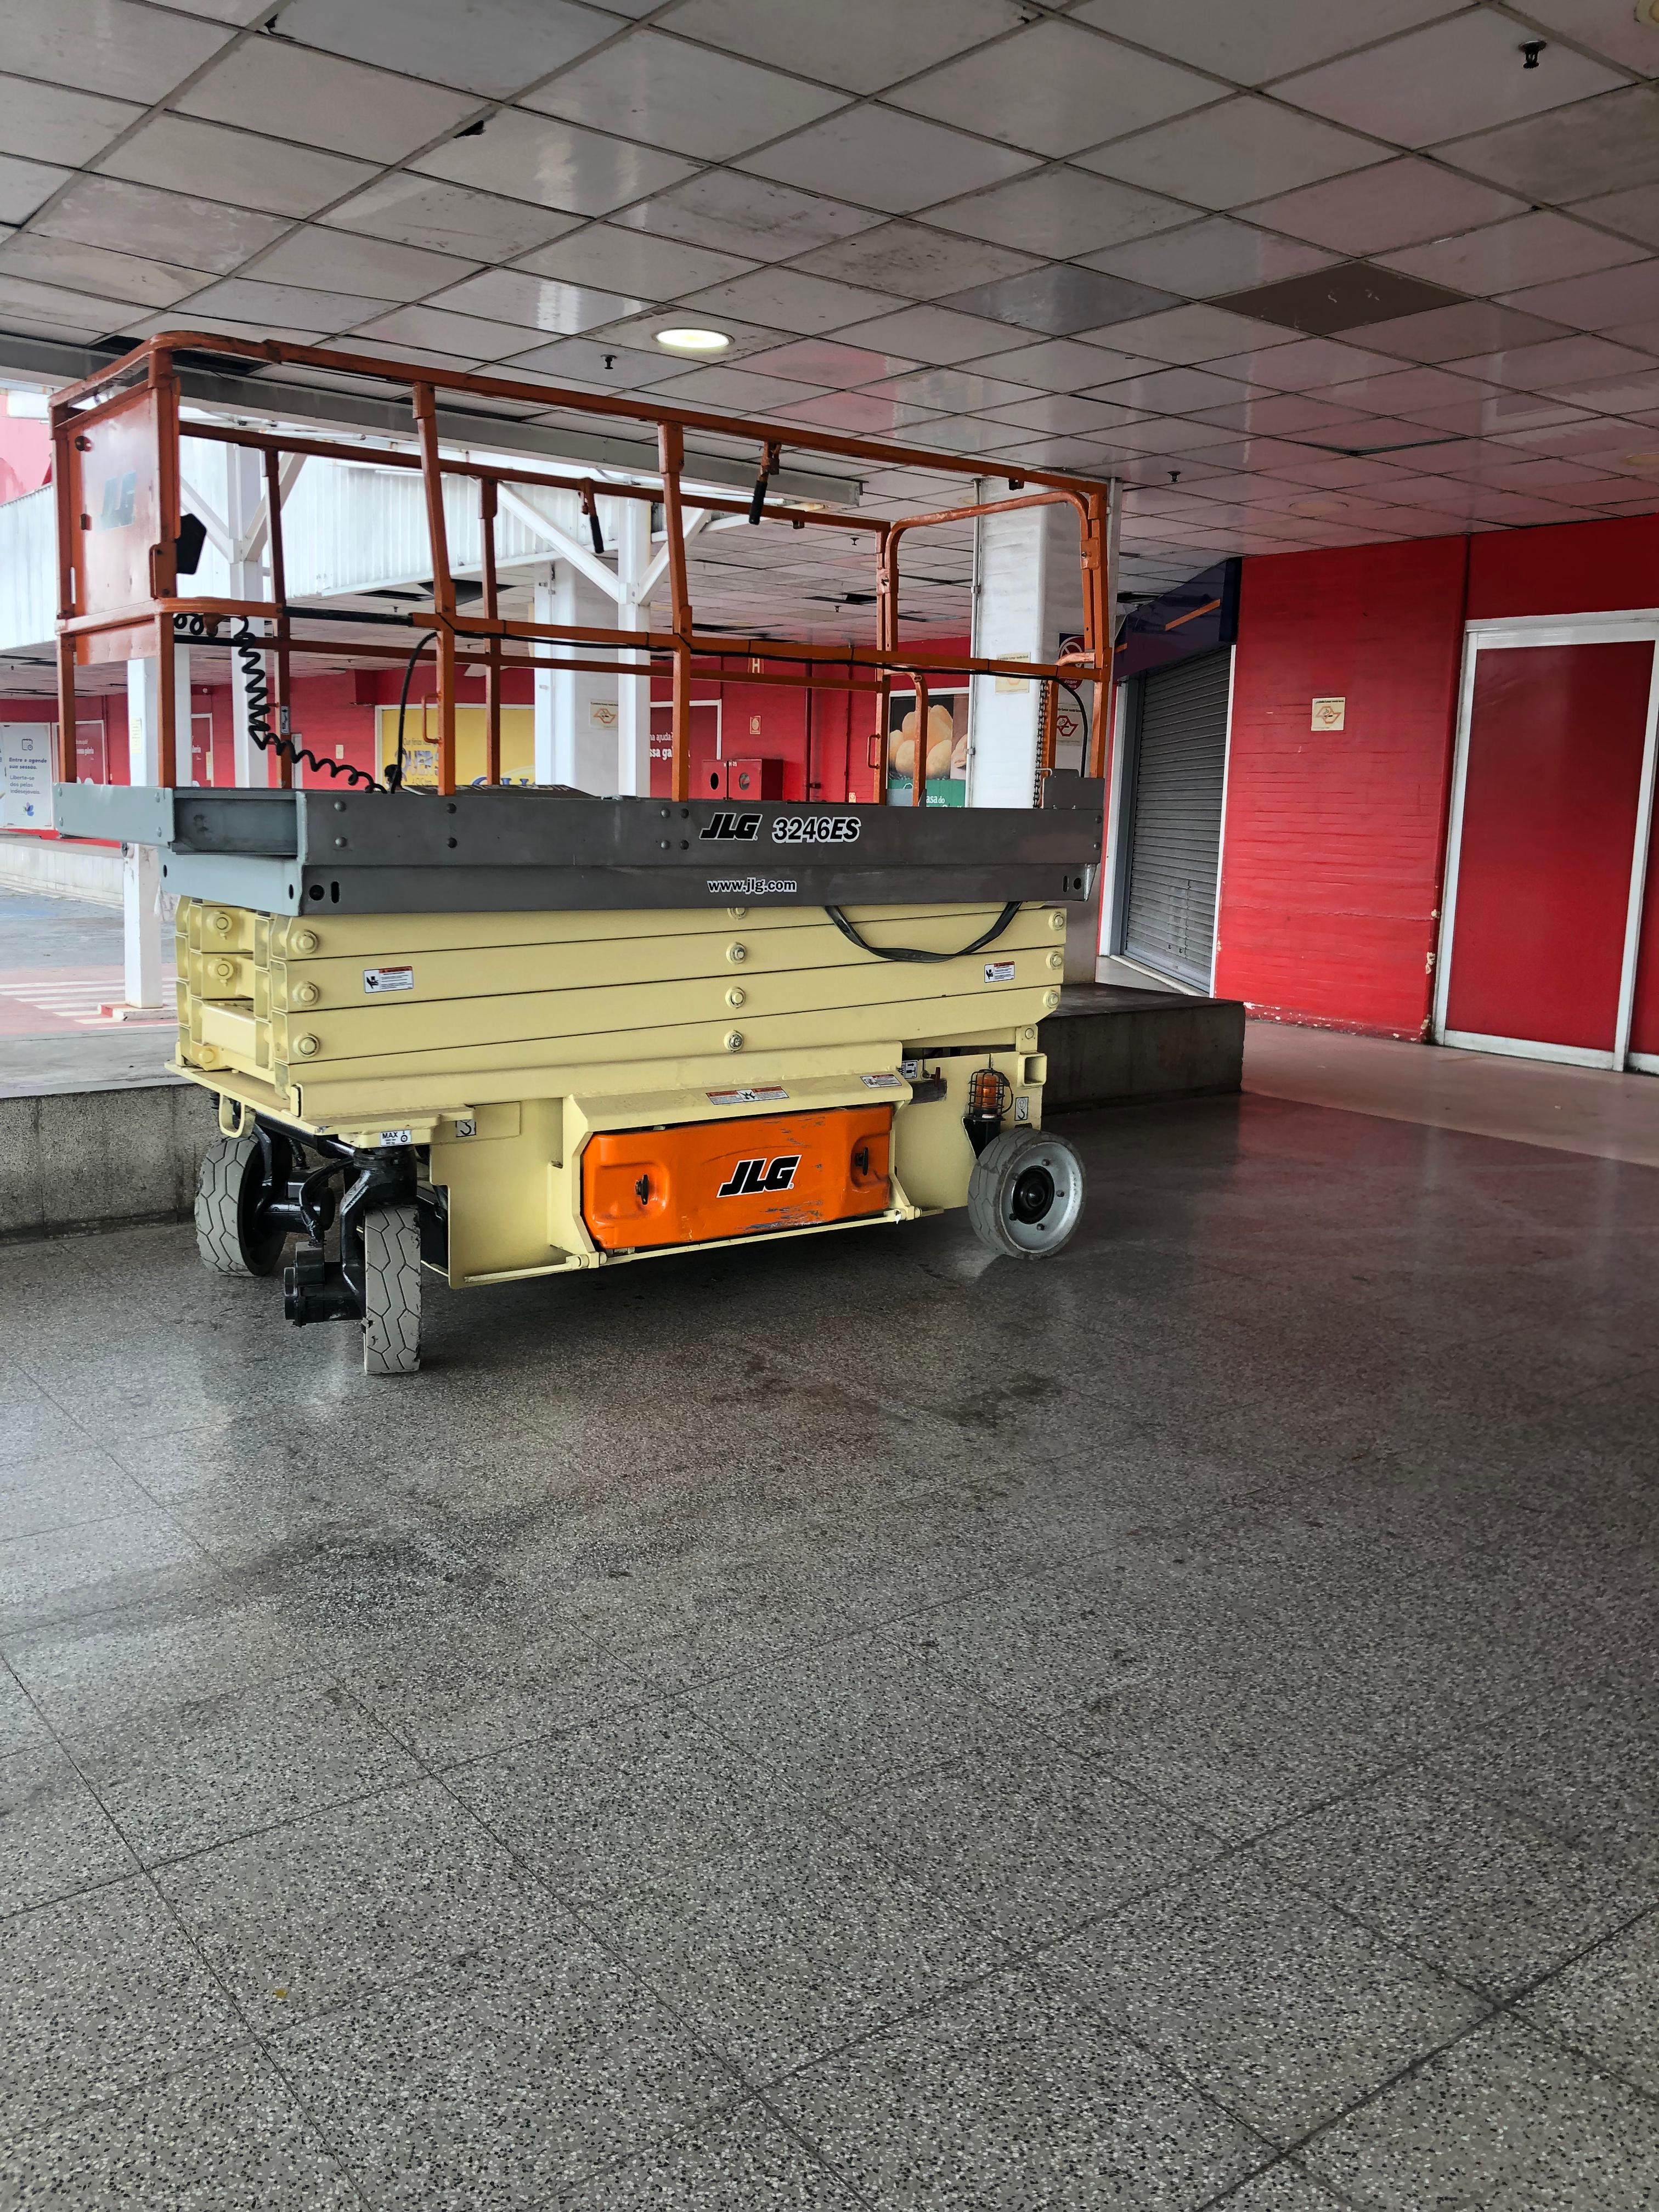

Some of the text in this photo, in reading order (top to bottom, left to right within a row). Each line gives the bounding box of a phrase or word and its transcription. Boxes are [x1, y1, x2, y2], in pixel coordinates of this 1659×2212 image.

[752, 658, 760, 674] H
[926, 795, 945, 804] asa do
[700, 813, 861, 842] JLG 3246ES
[707, 878, 797, 894] www.jlg.com
[717, 1155, 802, 1197] JLG
